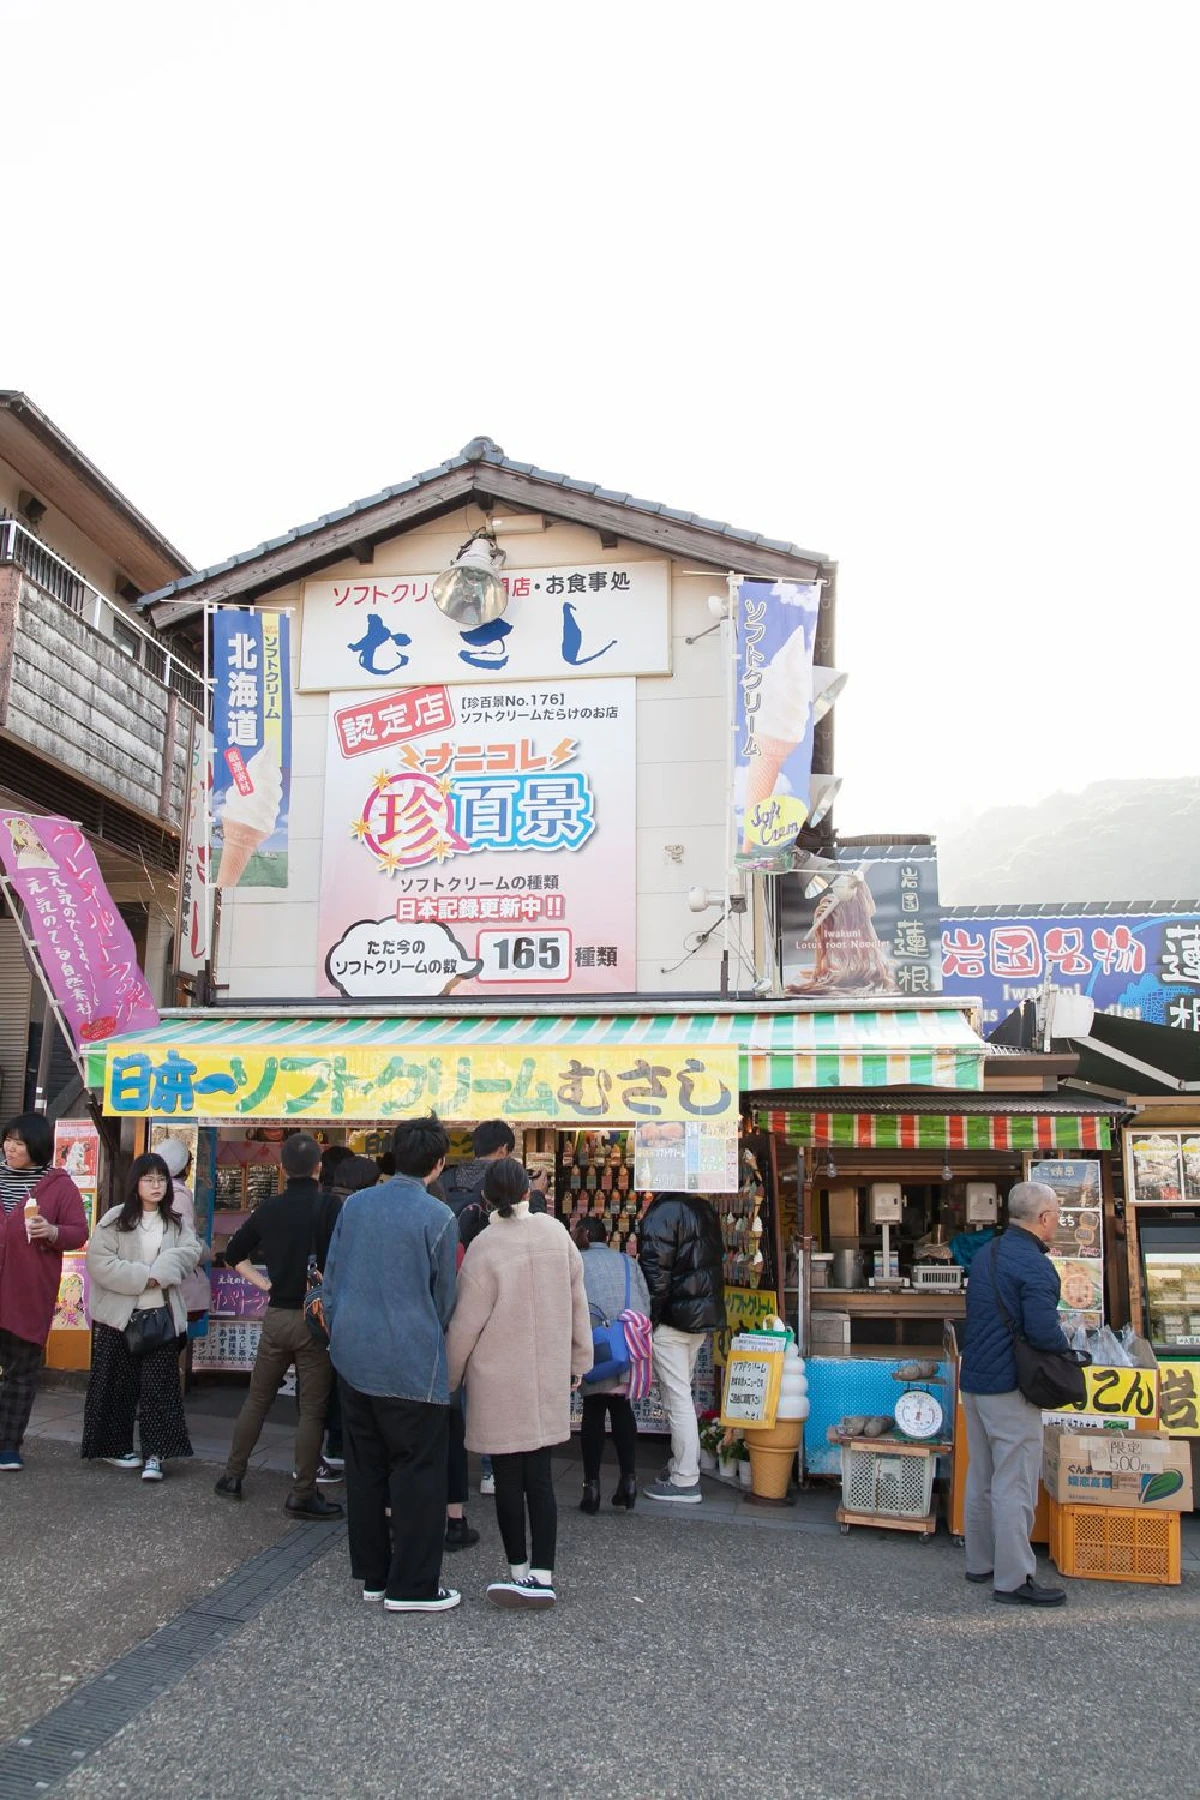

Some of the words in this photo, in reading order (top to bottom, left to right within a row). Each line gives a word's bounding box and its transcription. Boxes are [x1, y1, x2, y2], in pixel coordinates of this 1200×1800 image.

[227, 633, 258, 747] 北海道
[264, 635, 281, 720] ソフトクリーム
[743, 600, 766, 757] ソフトクリーム
[341, 691, 446, 749] 認定店
[461, 706, 618, 723] ソフトクリームだらけのお店
[424, 739, 548, 771] ナニコレ
[376, 781, 583, 853] 珍百景
[751, 801, 781, 829] Soft
[401, 874, 559, 893] ソフトクリームの種類
[367, 939, 426, 956] ただ今の
[795, 941, 823, 949] Lotus
[824, 929, 861, 938] Iwakuni
[336, 958, 457, 974] ソフトクリームの数
[493, 936, 560, 971] 165
[575, 947, 618, 968] 種類
[1110, 1441, 1141, 1454] 限定
